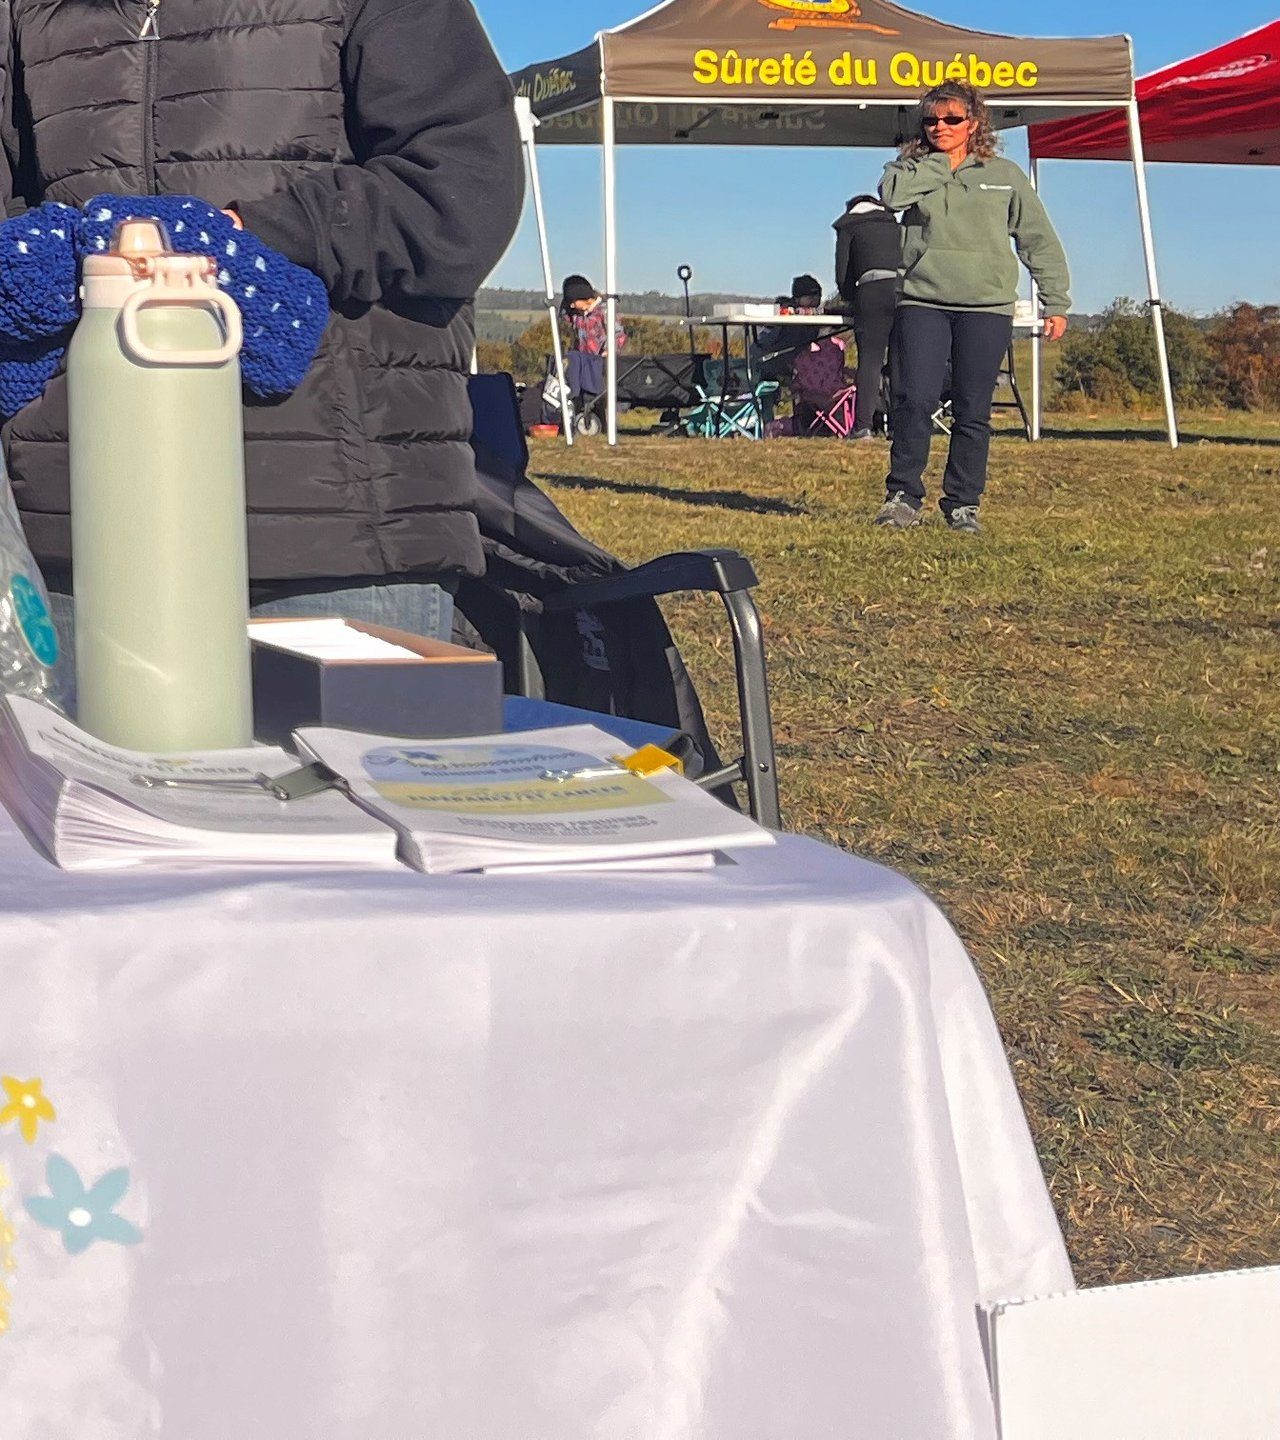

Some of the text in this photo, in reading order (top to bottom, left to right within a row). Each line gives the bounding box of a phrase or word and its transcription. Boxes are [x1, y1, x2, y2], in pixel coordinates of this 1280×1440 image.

[692, 49, 1039, 89] Sûreté du Québec
